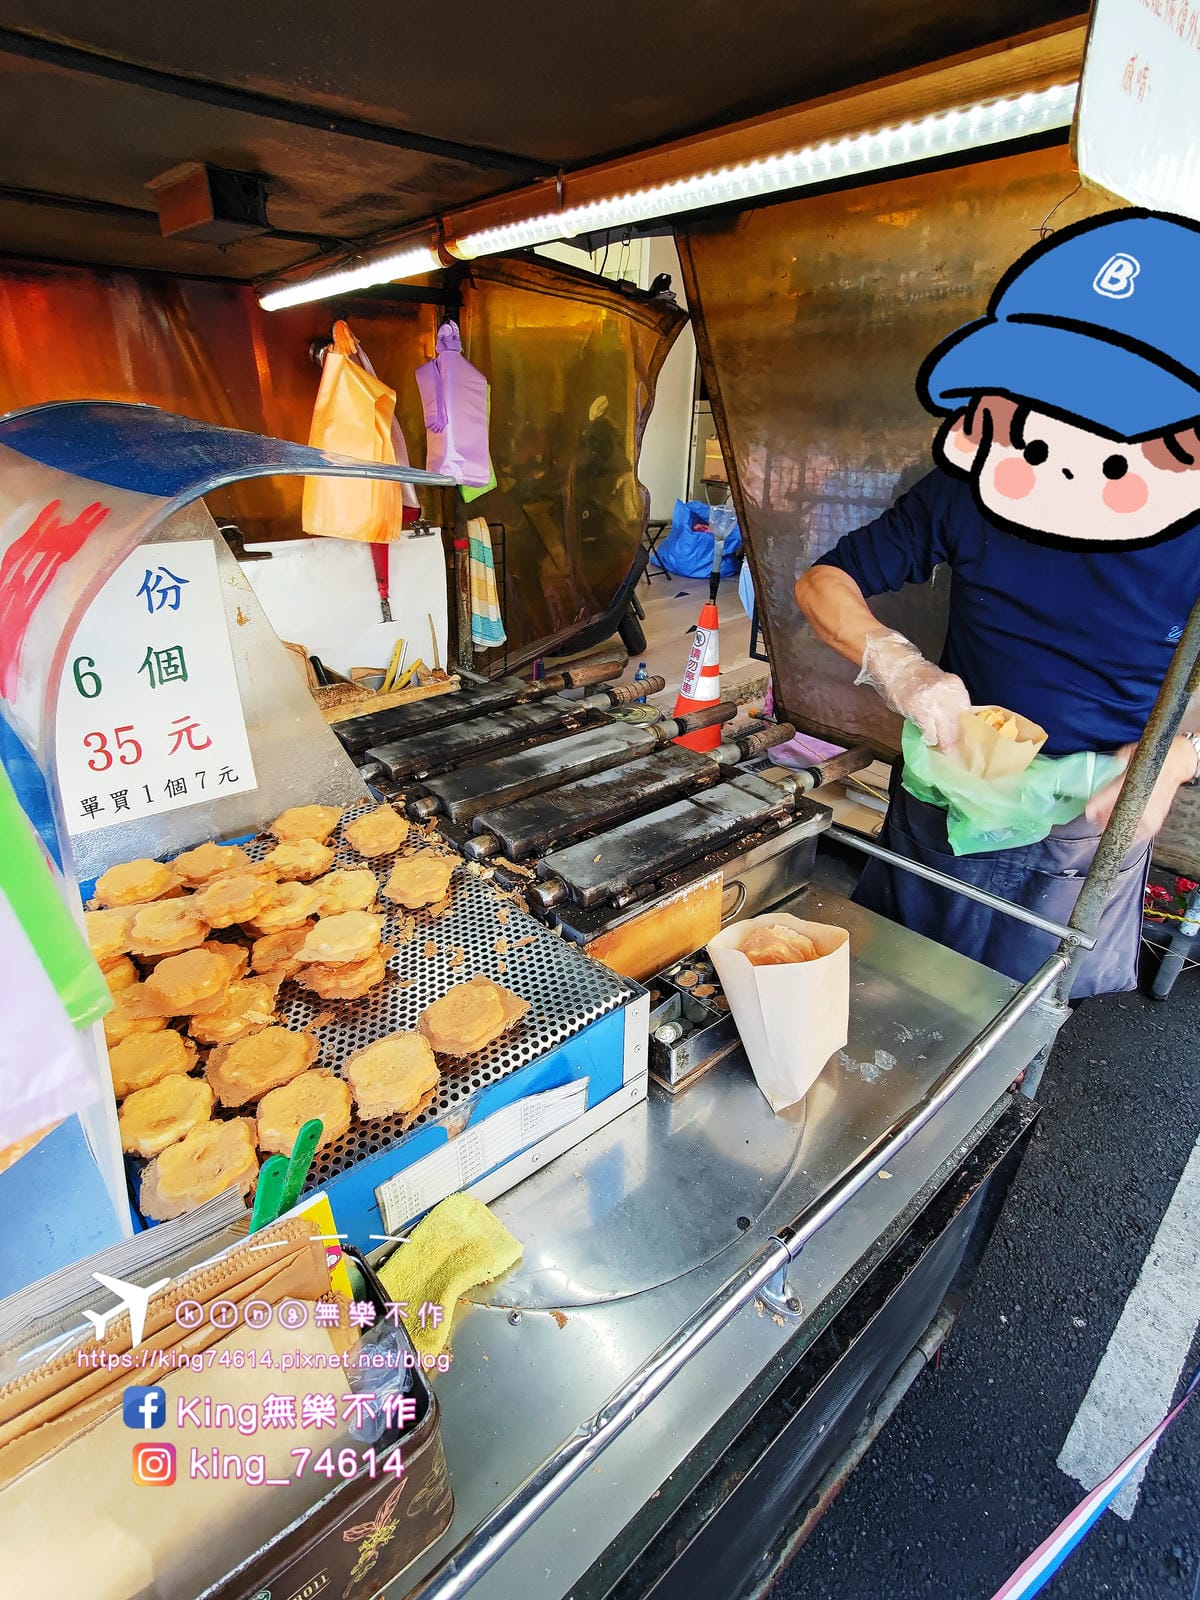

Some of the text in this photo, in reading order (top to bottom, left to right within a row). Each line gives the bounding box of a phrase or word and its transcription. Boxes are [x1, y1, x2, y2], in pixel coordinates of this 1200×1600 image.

[136, 566, 190, 614] 份
[72, 645, 189, 699] 6 個
[83, 715, 213, 772] 35 元
